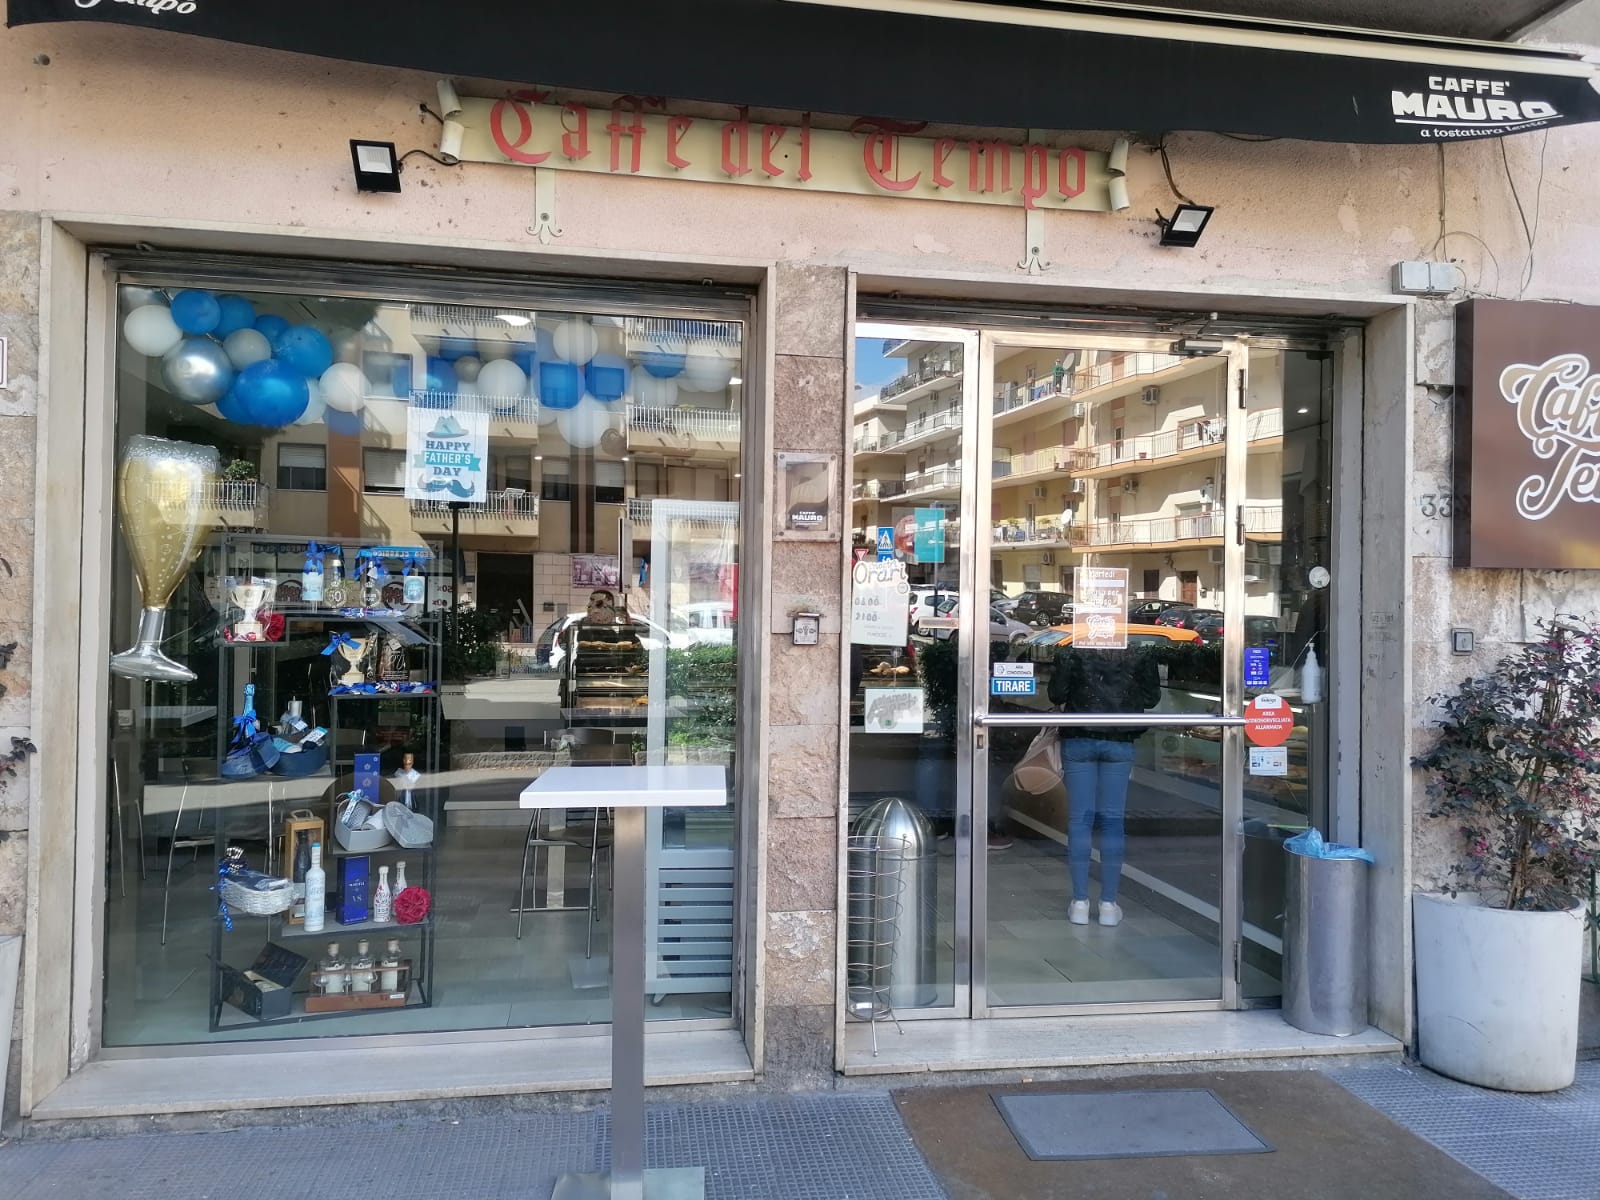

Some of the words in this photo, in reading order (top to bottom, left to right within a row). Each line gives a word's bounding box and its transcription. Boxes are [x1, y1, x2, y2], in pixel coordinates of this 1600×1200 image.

[1429, 76, 1510, 96] CAFFE'
[1392, 91, 1558, 121] MAURO
[1420, 129, 1431, 138] a
[1434, 127, 1503, 138] tostatura
[721, 105, 812, 182] del
[851, 117, 1086, 211] Tempo
[425, 440, 471, 451] HAPPY
[424, 452, 471, 464] FATHER'S
[433, 467, 461, 476] DAY
[854, 561, 907, 584] Orari
[995, 680, 1031, 692] TIRARE
